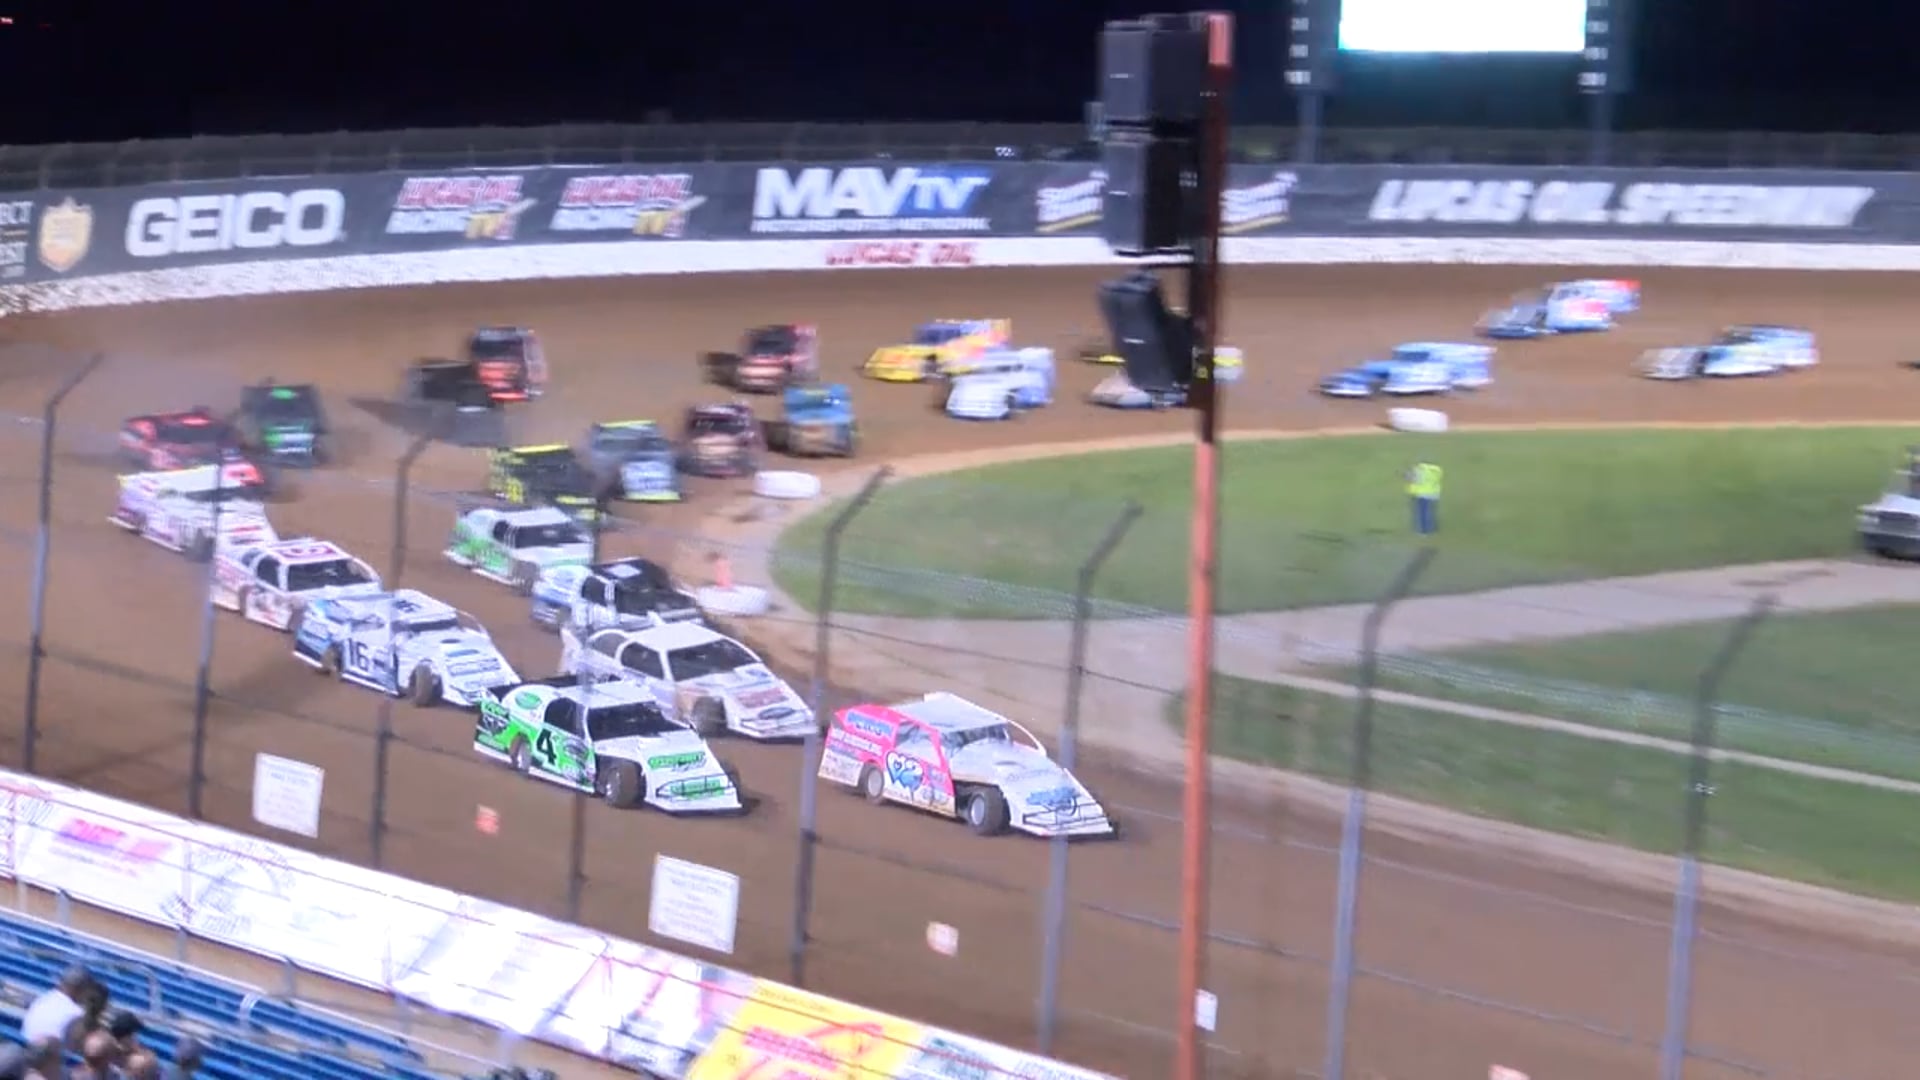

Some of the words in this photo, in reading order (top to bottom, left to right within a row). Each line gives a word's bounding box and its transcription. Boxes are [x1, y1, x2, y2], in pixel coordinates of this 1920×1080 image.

[753, 167, 990, 217] MAVTV
[1368, 179, 1533, 222] LUCAS
[1528, 180, 1617, 223] OIL
[1614, 182, 1876, 227] SPEEDWAY
[125, 189, 346, 257] GEICO
[348, 637, 370, 672] 16
[536, 728, 558, 766] 4
